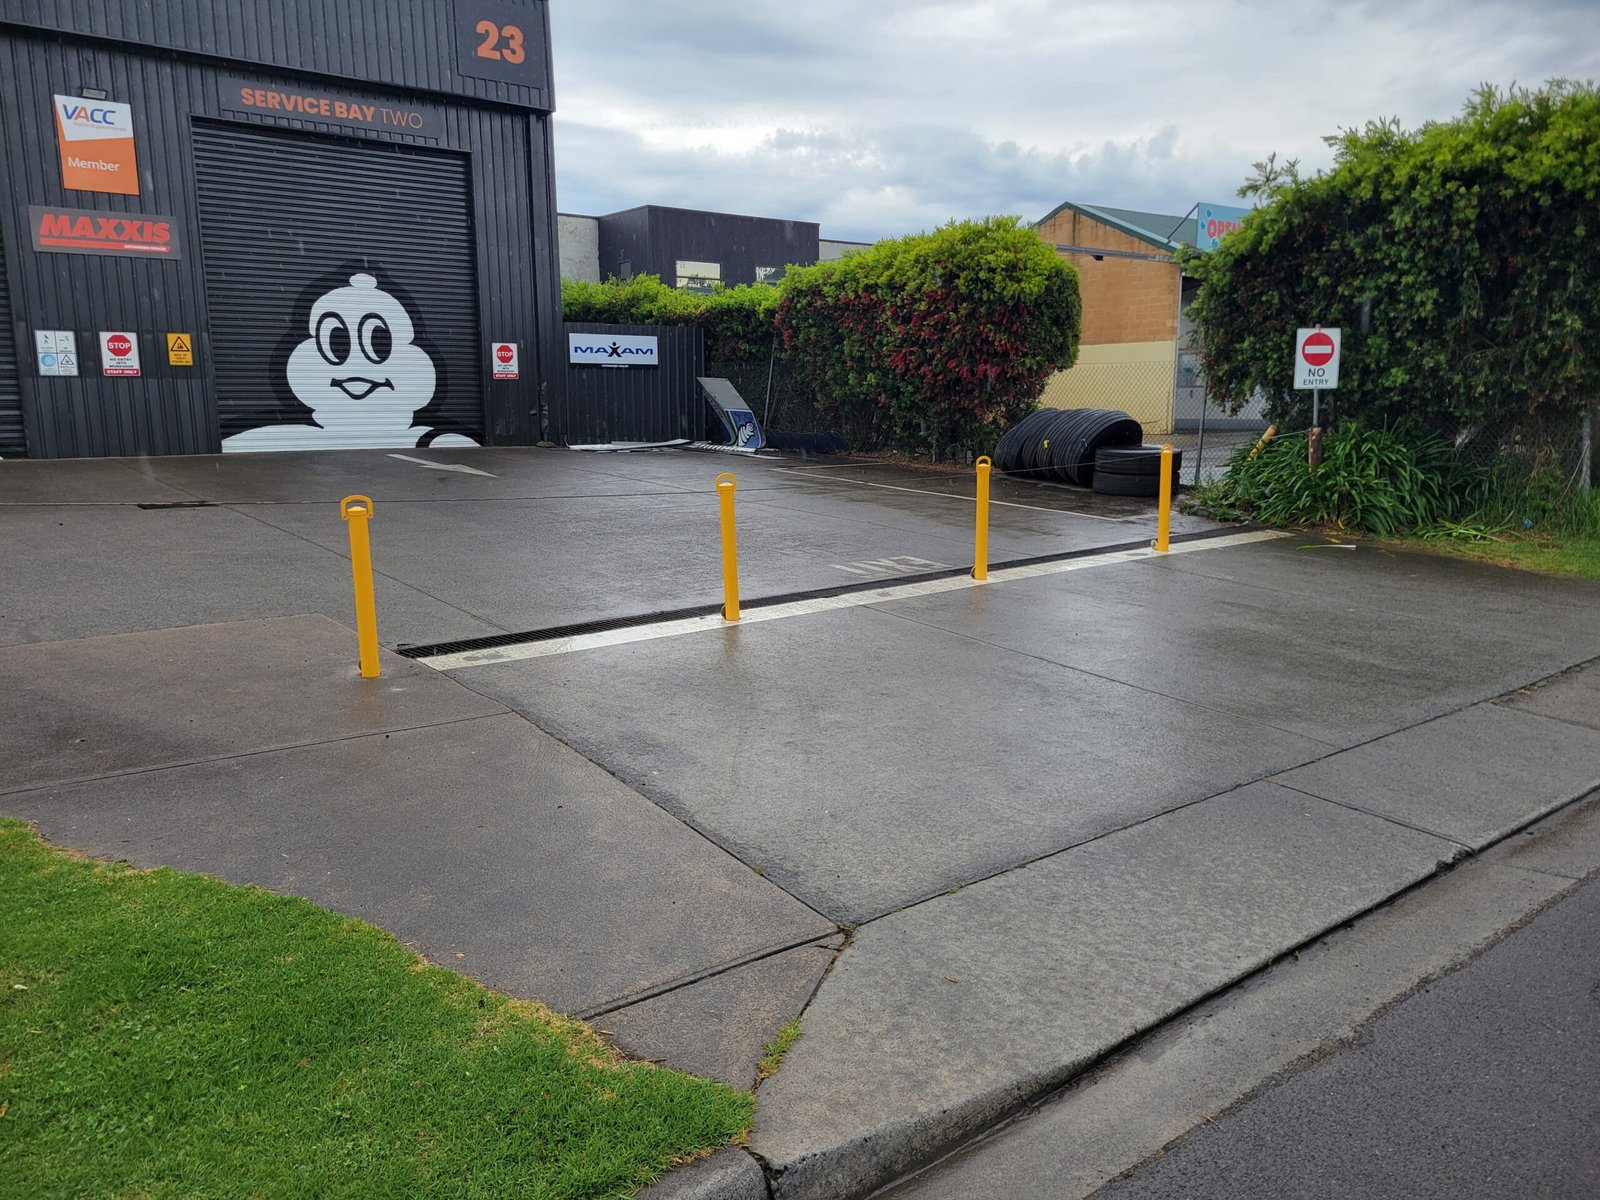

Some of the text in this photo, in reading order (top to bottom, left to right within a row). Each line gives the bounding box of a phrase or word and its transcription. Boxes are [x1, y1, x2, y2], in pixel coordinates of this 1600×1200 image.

[475, 20, 526, 65] 23
[62, 103, 117, 126] VACC
[240, 87, 423, 129] SERVICE BAY TWO
[67, 156, 120, 172] Member
[39, 213, 171, 244] MAXXIS
[108, 341, 131, 350] STOP
[574, 342, 654, 358] MAXAM
[1308, 368, 1325, 377] NO
